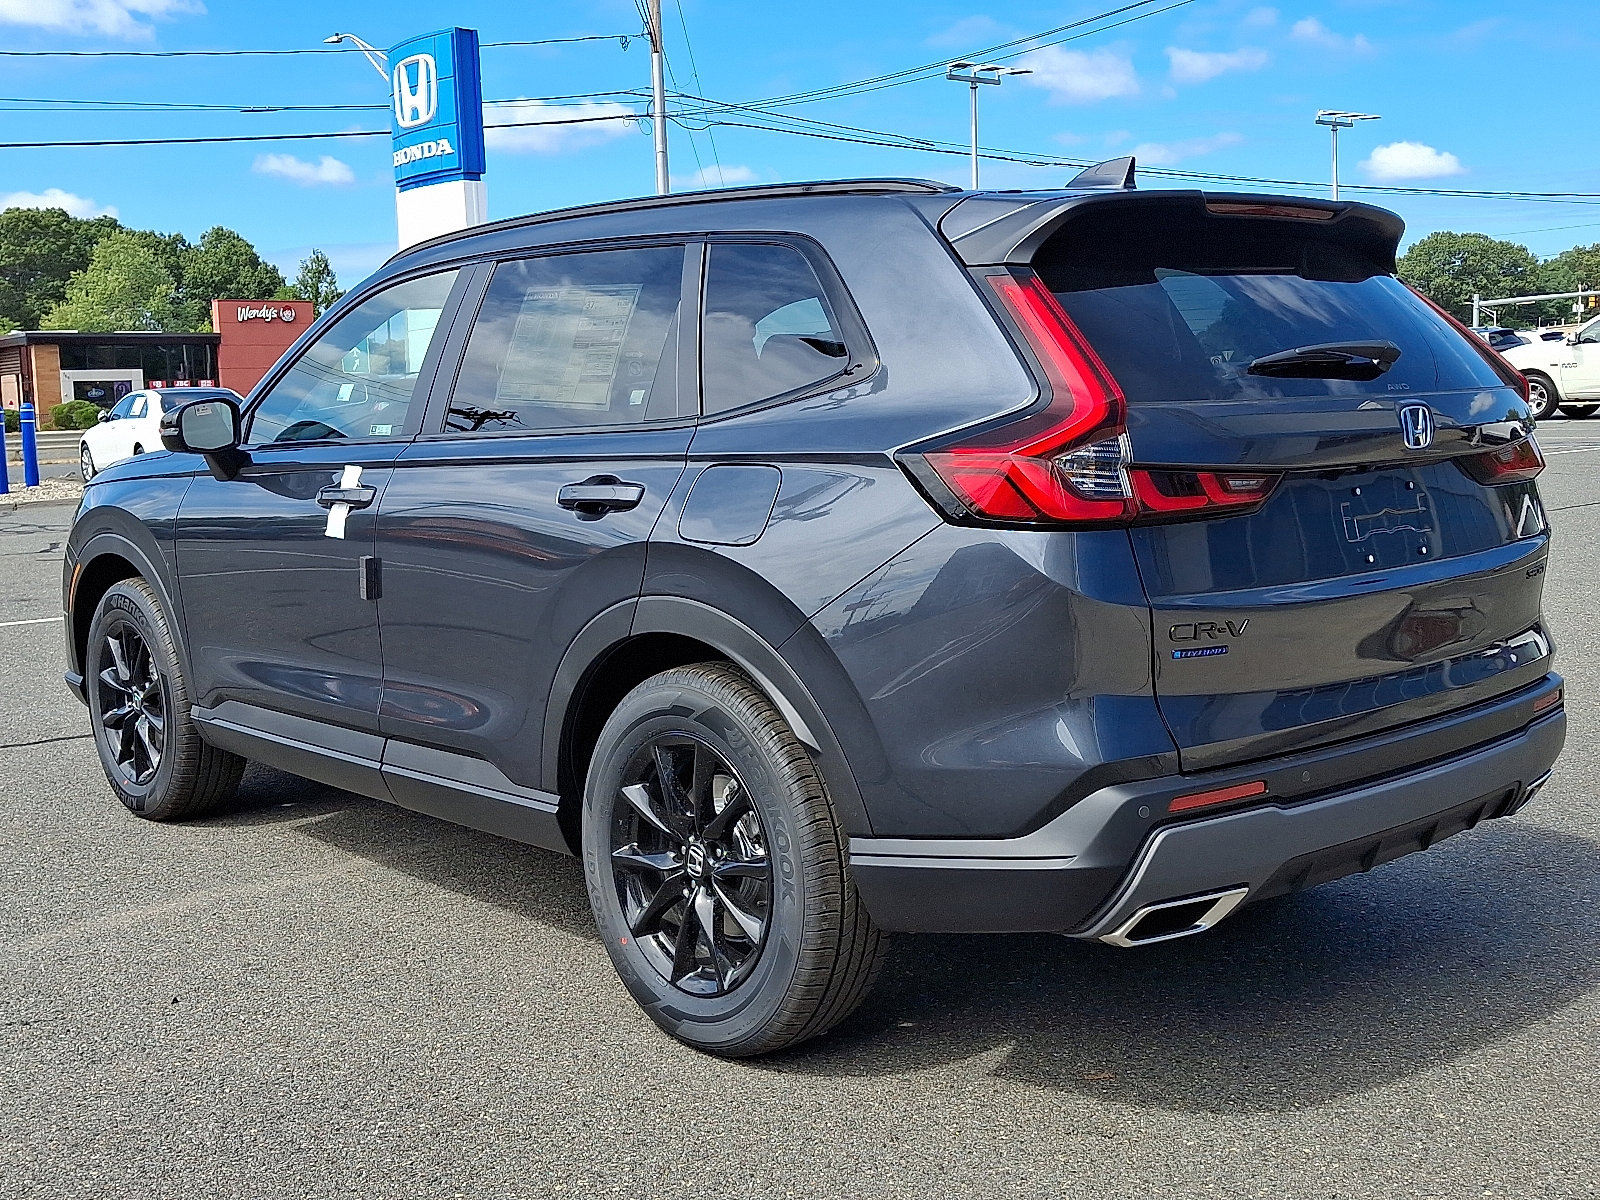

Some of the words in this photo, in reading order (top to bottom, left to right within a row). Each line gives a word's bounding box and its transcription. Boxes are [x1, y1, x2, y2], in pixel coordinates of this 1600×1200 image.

[393, 138, 455, 167] HONDA
[237, 304, 278, 322] Wendy's
[1387, 383, 1410, 391] AWD
[1168, 618, 1250, 643] CR-V
